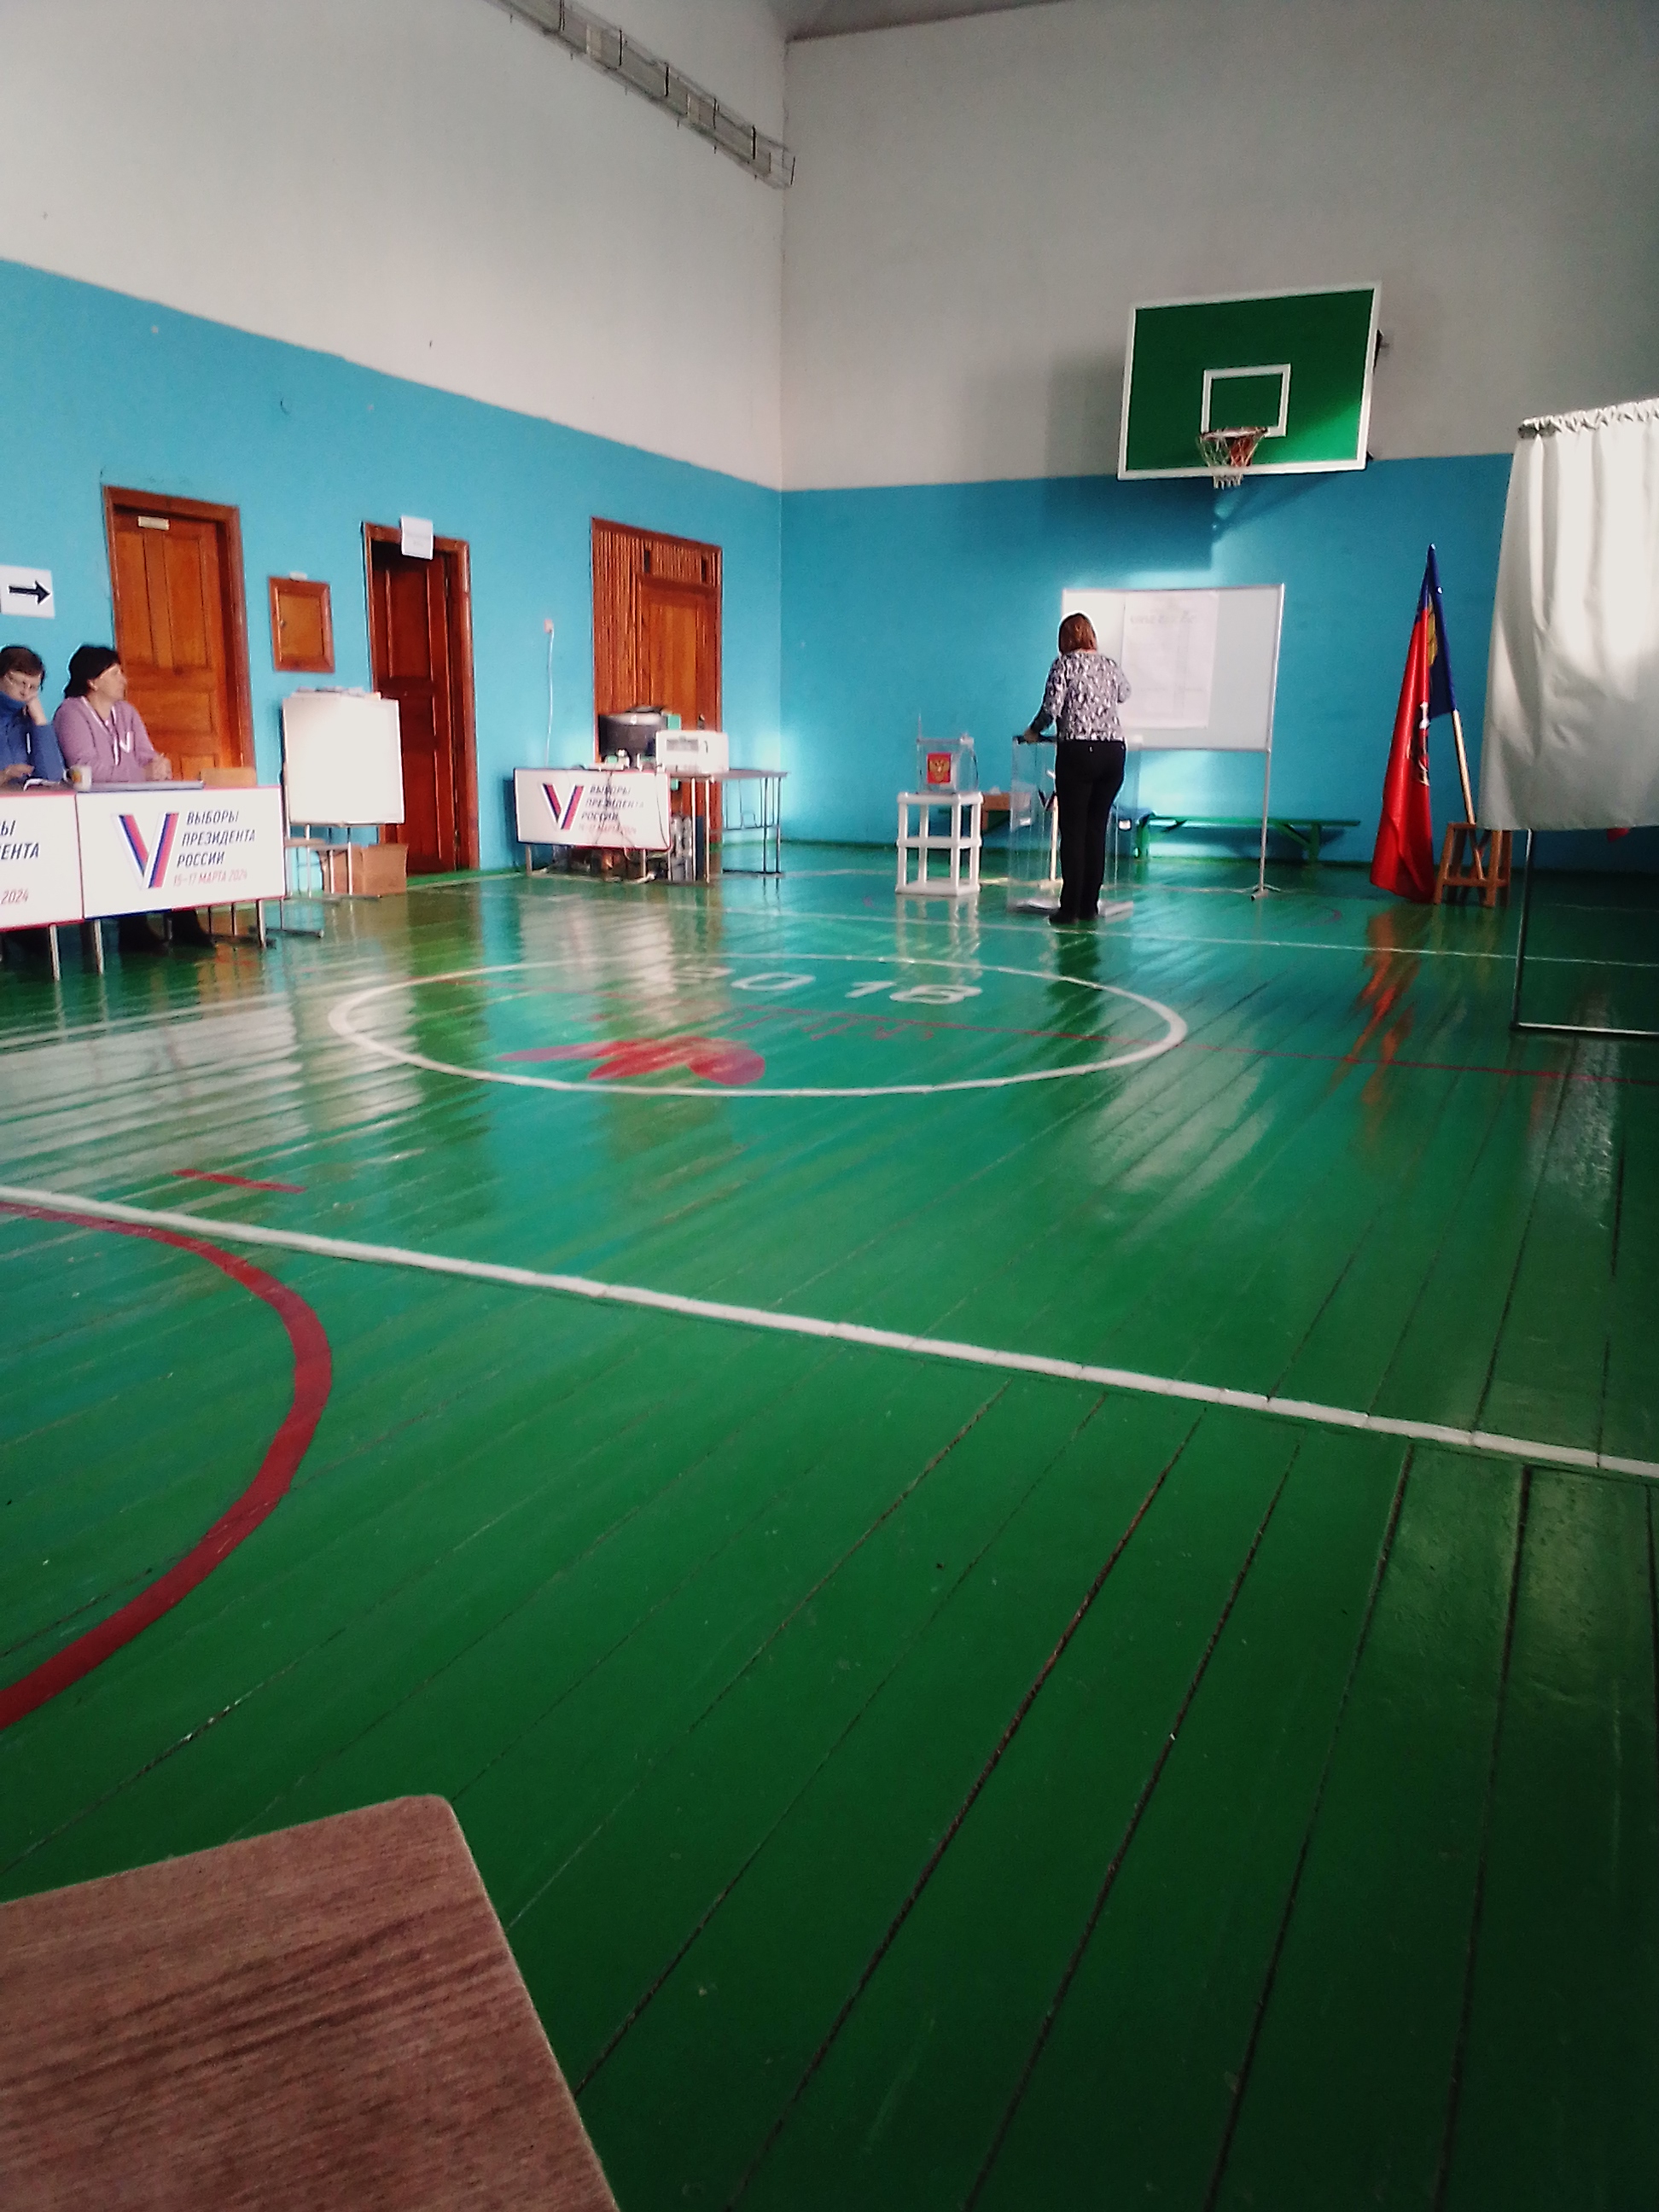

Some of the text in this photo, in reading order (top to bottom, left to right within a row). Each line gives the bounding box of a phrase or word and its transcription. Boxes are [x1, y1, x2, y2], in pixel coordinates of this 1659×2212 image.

[186, 810, 240, 826] ВЫБОРЫ
[181, 829, 256, 847] ПРЕЗИДЕНТА
[0, 841, 39, 860] ЕНТА
[176, 851, 226, 869] РОССИИ
[199, 870, 227, 884] МАРТА
[228, 868, 248, 882] 2024
[1, 888, 29, 905] 2024
